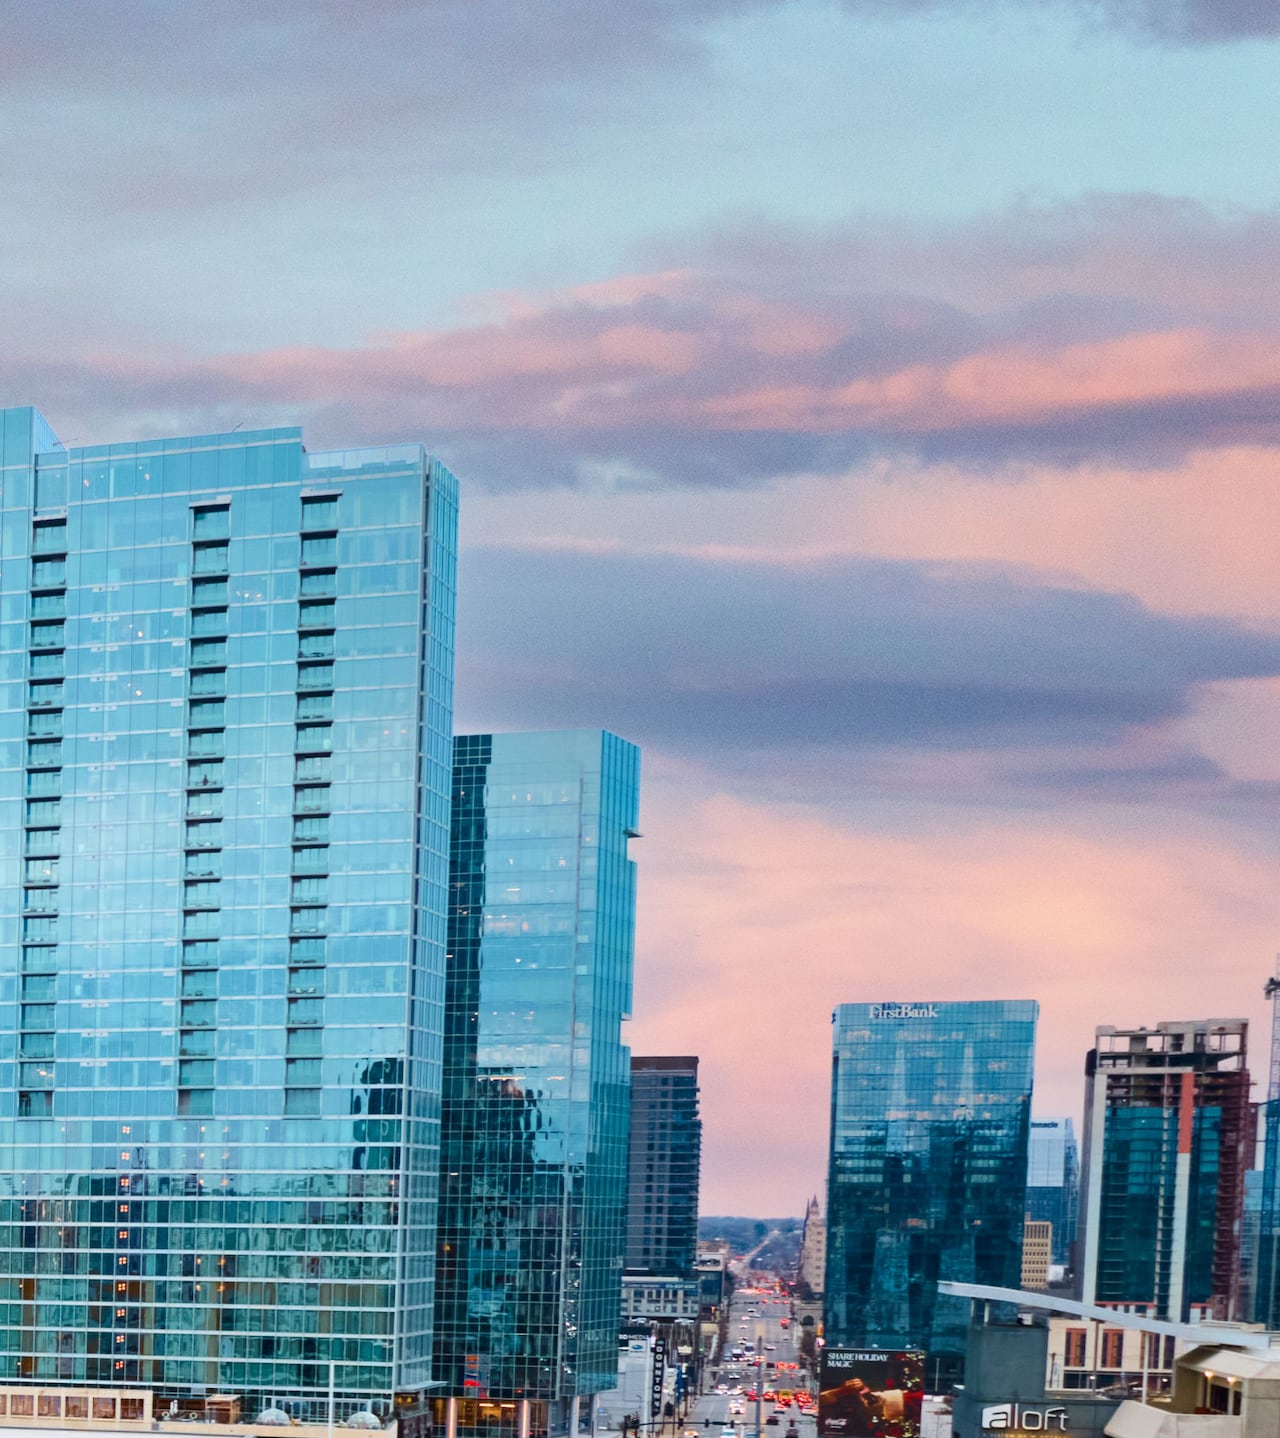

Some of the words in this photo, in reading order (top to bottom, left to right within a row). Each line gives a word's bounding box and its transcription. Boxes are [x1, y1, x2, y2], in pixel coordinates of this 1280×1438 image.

[868, 1003, 940, 1019] FirstBank
[827, 1352, 855, 1361] SHARE
[855, 1353, 889, 1361] HOLIDAY
[827, 1360, 853, 1368] MAGIC
[981, 1403, 1070, 1431] aloft
